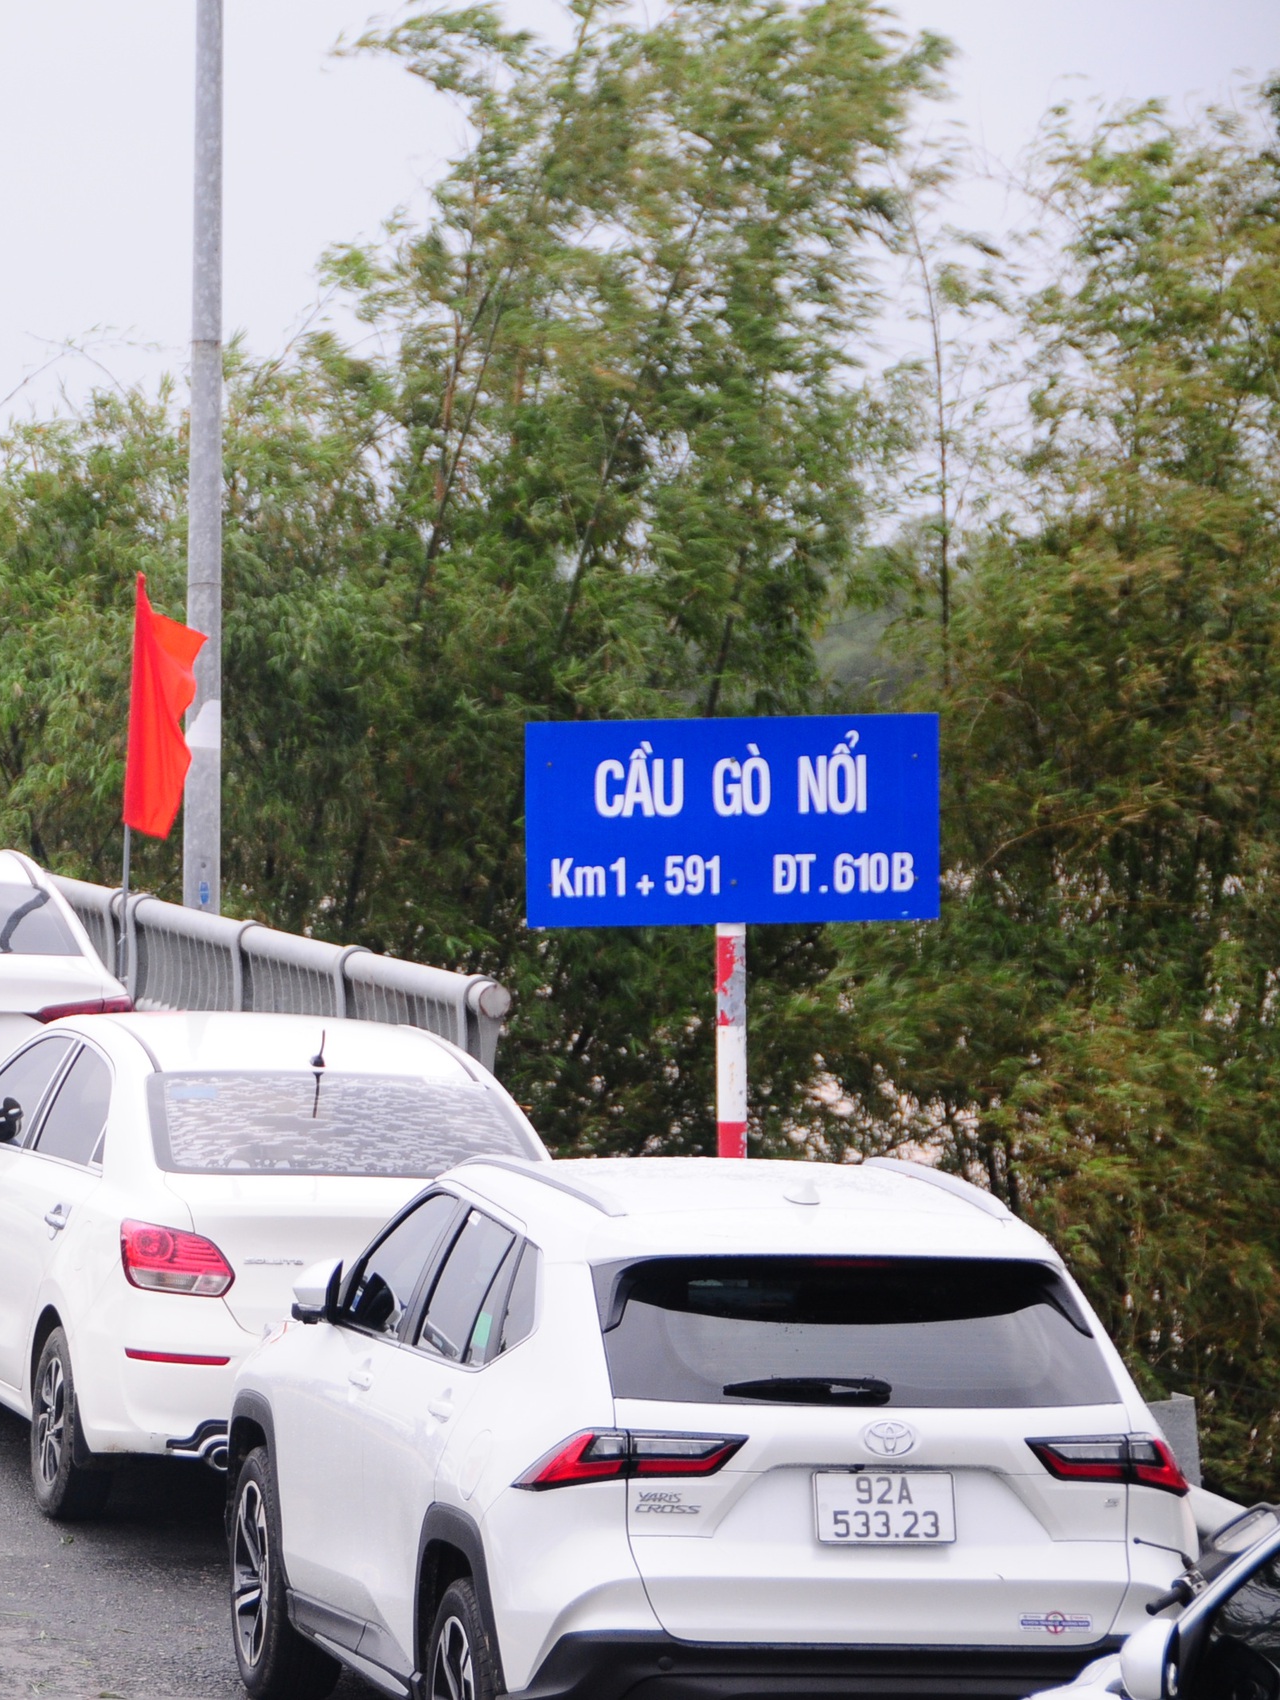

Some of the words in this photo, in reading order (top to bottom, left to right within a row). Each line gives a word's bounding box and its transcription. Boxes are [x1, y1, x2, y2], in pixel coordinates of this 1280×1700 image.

[594, 741, 684, 817] CẦU
[712, 743, 771, 816] GÒ
[797, 730, 867, 815] NỔI
[855, 1476, 914, 1505] 92A
[634, 1503, 702, 1514] CROSS
[832, 1510, 940, 1539] 533.23
